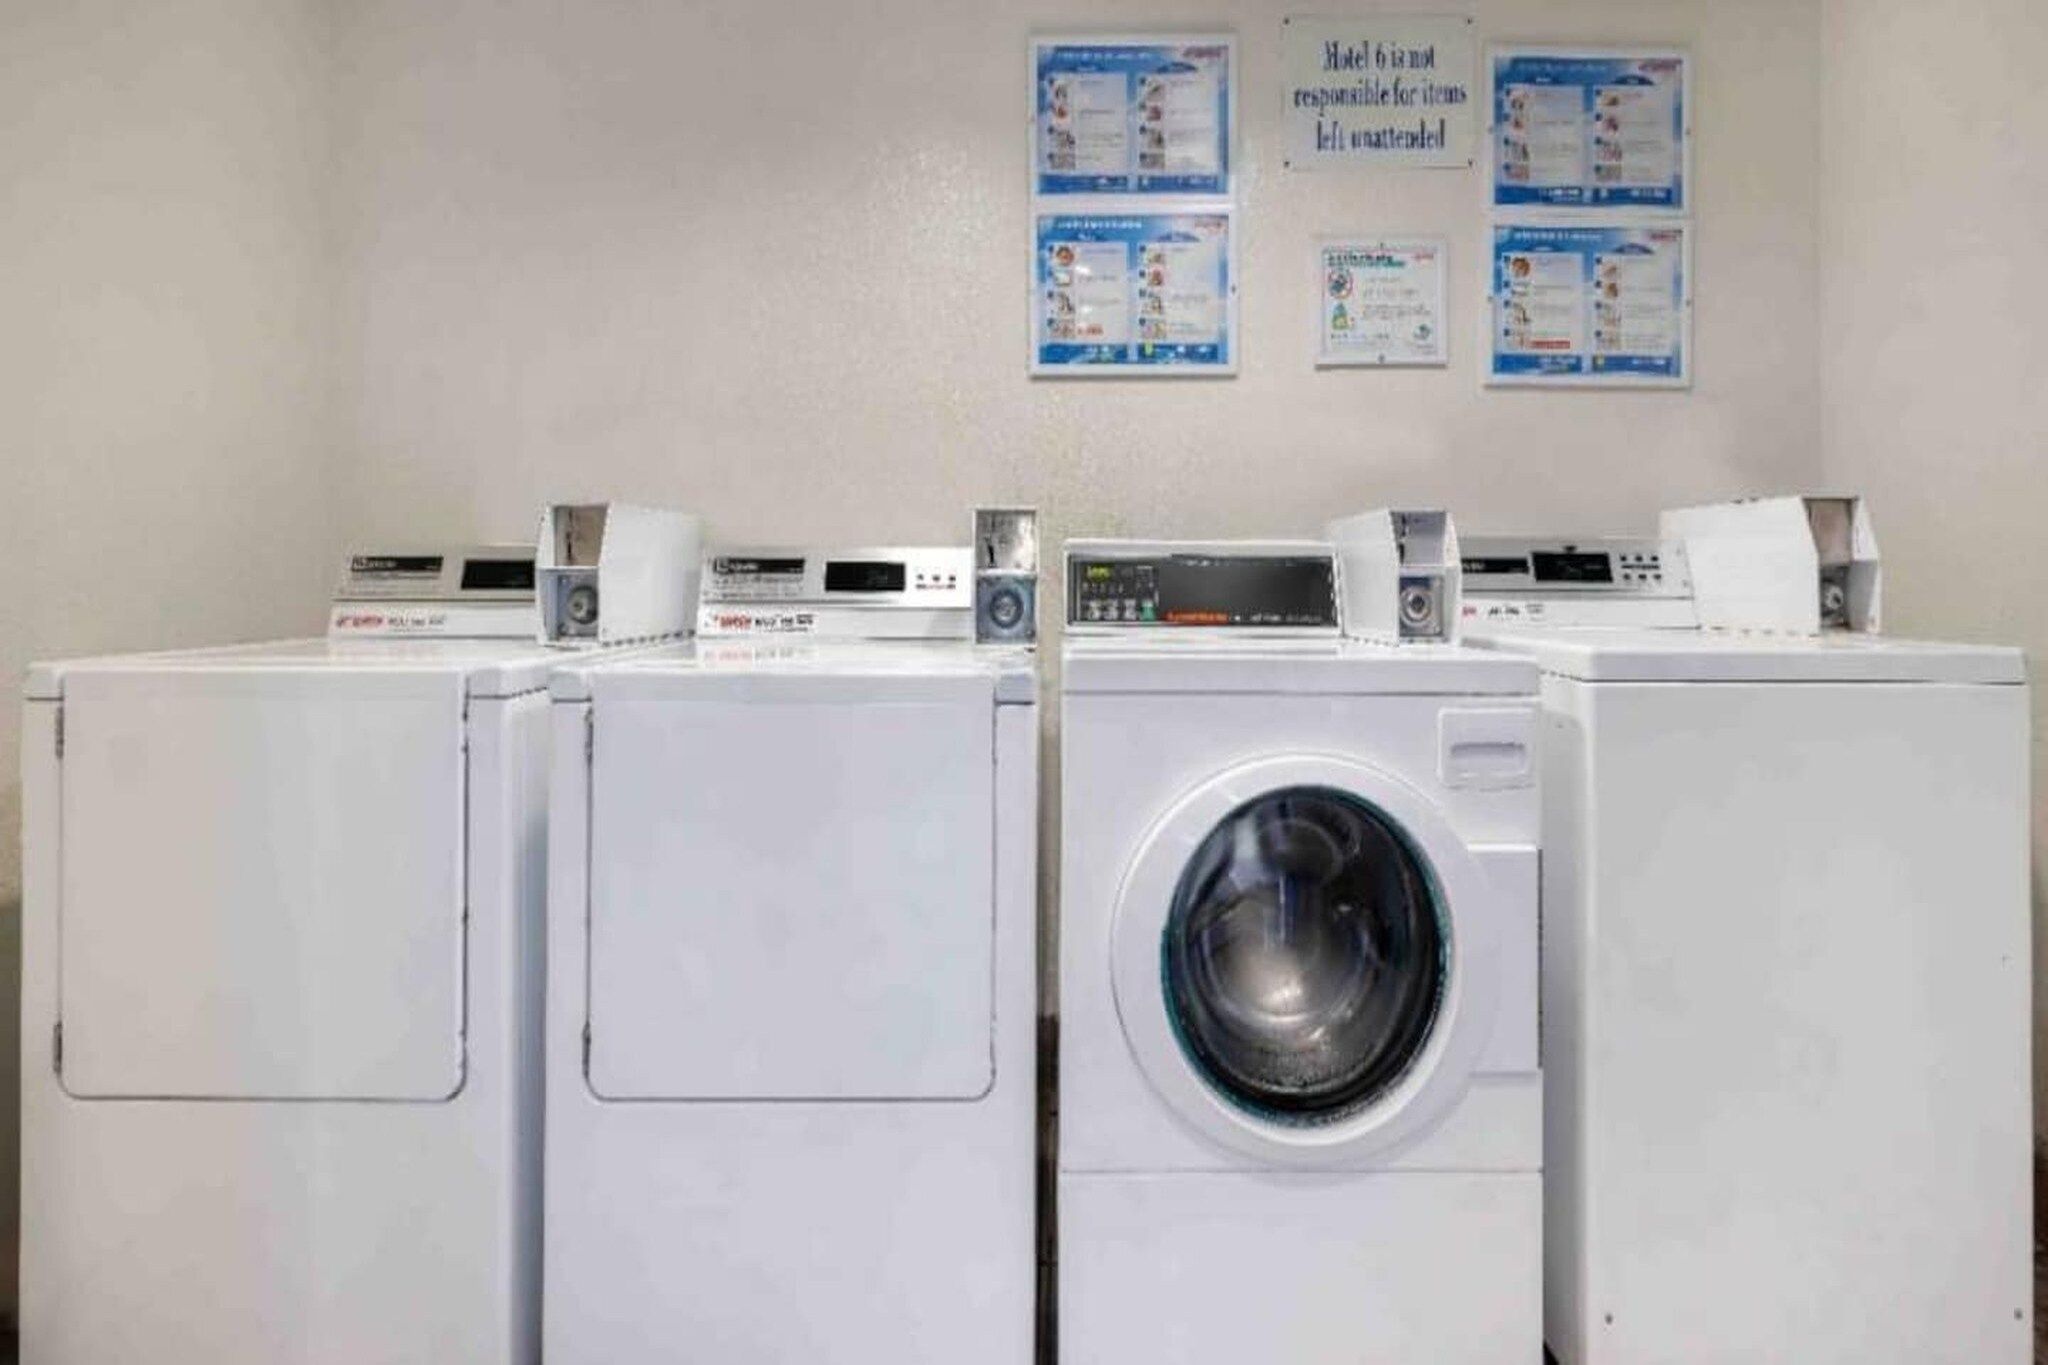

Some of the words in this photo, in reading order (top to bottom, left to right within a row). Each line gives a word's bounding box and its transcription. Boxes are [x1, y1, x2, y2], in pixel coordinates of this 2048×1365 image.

[1323, 40, 1369, 70] Motel
[1375, 42, 1386, 70] 6
[1391, 42, 1404, 69] is
[1409, 45, 1435, 69] not
[1294, 76, 1389, 117] responsible
[1393, 76, 1416, 107] for
[1422, 79, 1467, 107] items
[1317, 120, 1345, 151] left
[1351, 118, 1446, 150] unattended
